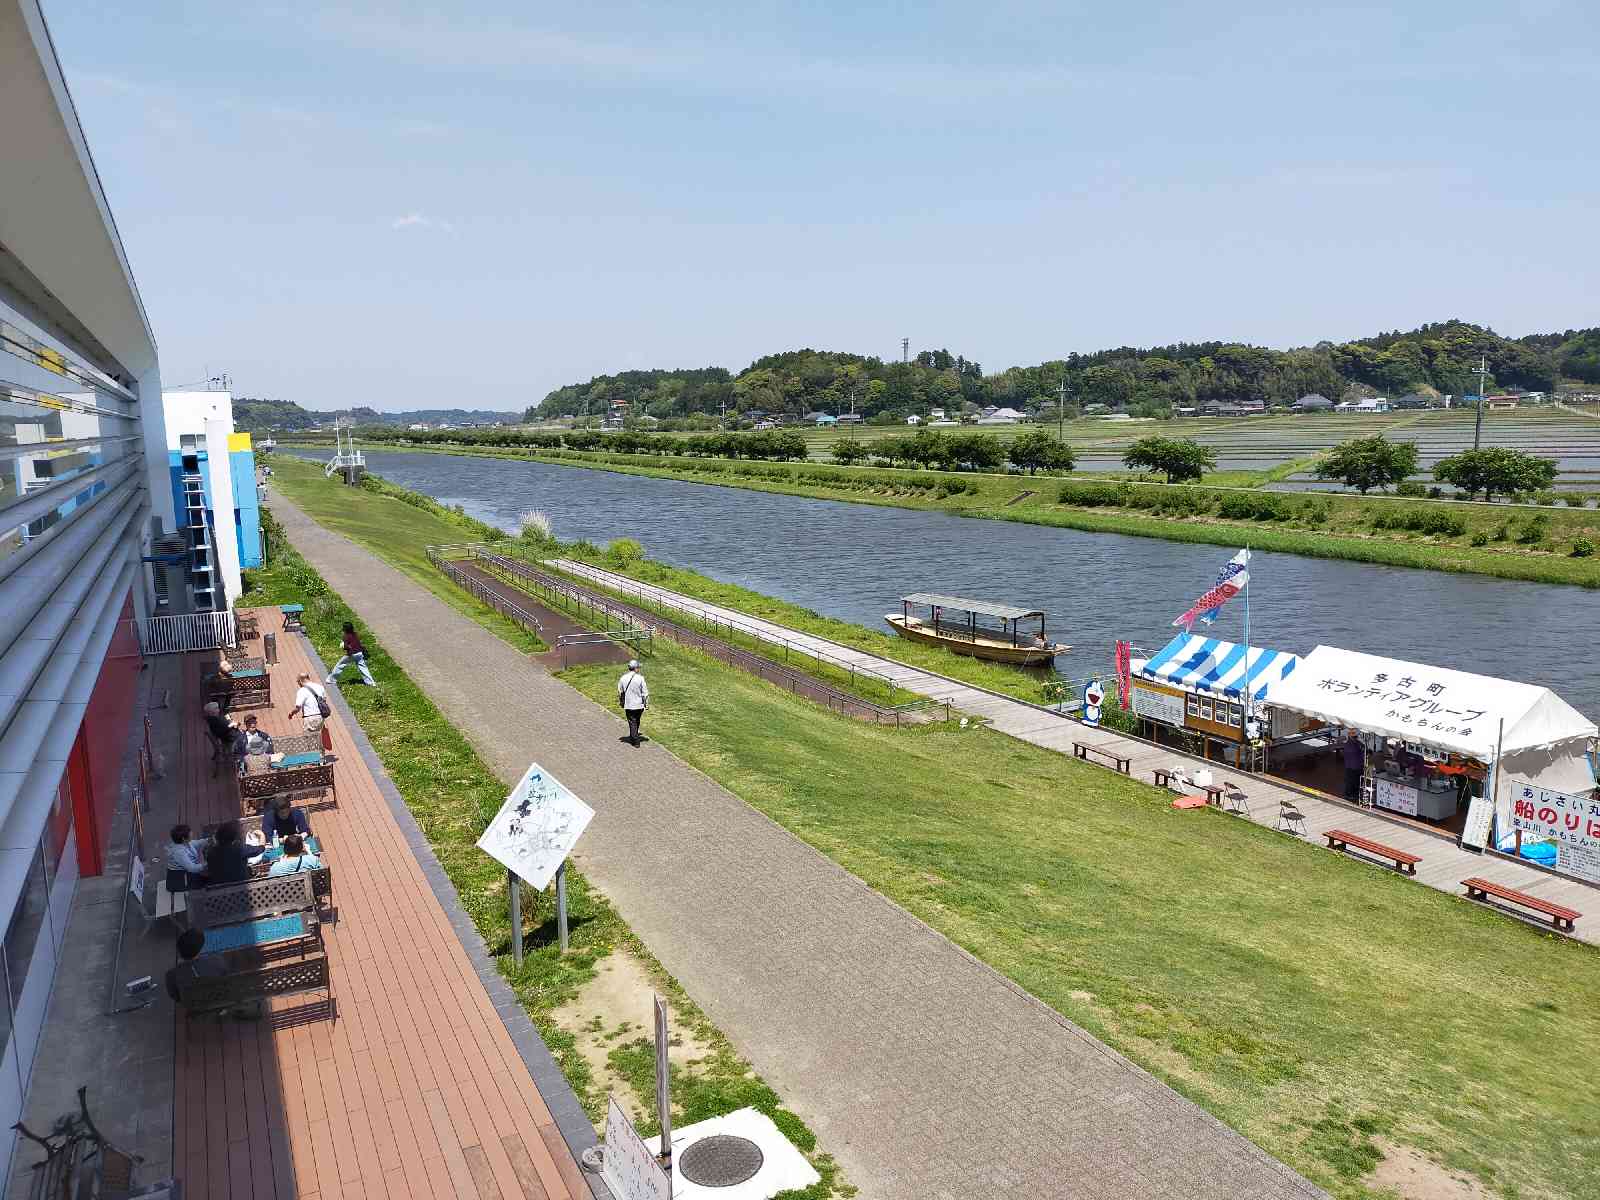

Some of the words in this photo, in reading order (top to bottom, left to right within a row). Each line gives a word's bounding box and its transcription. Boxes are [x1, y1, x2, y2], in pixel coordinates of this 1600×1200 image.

[1371, 673, 1447, 697] 多古町
[1317, 678, 1487, 722] ボランティアグループ
[1523, 788, 1600, 816] あじさい丸
[1548, 828, 1600, 848] かもちんの
